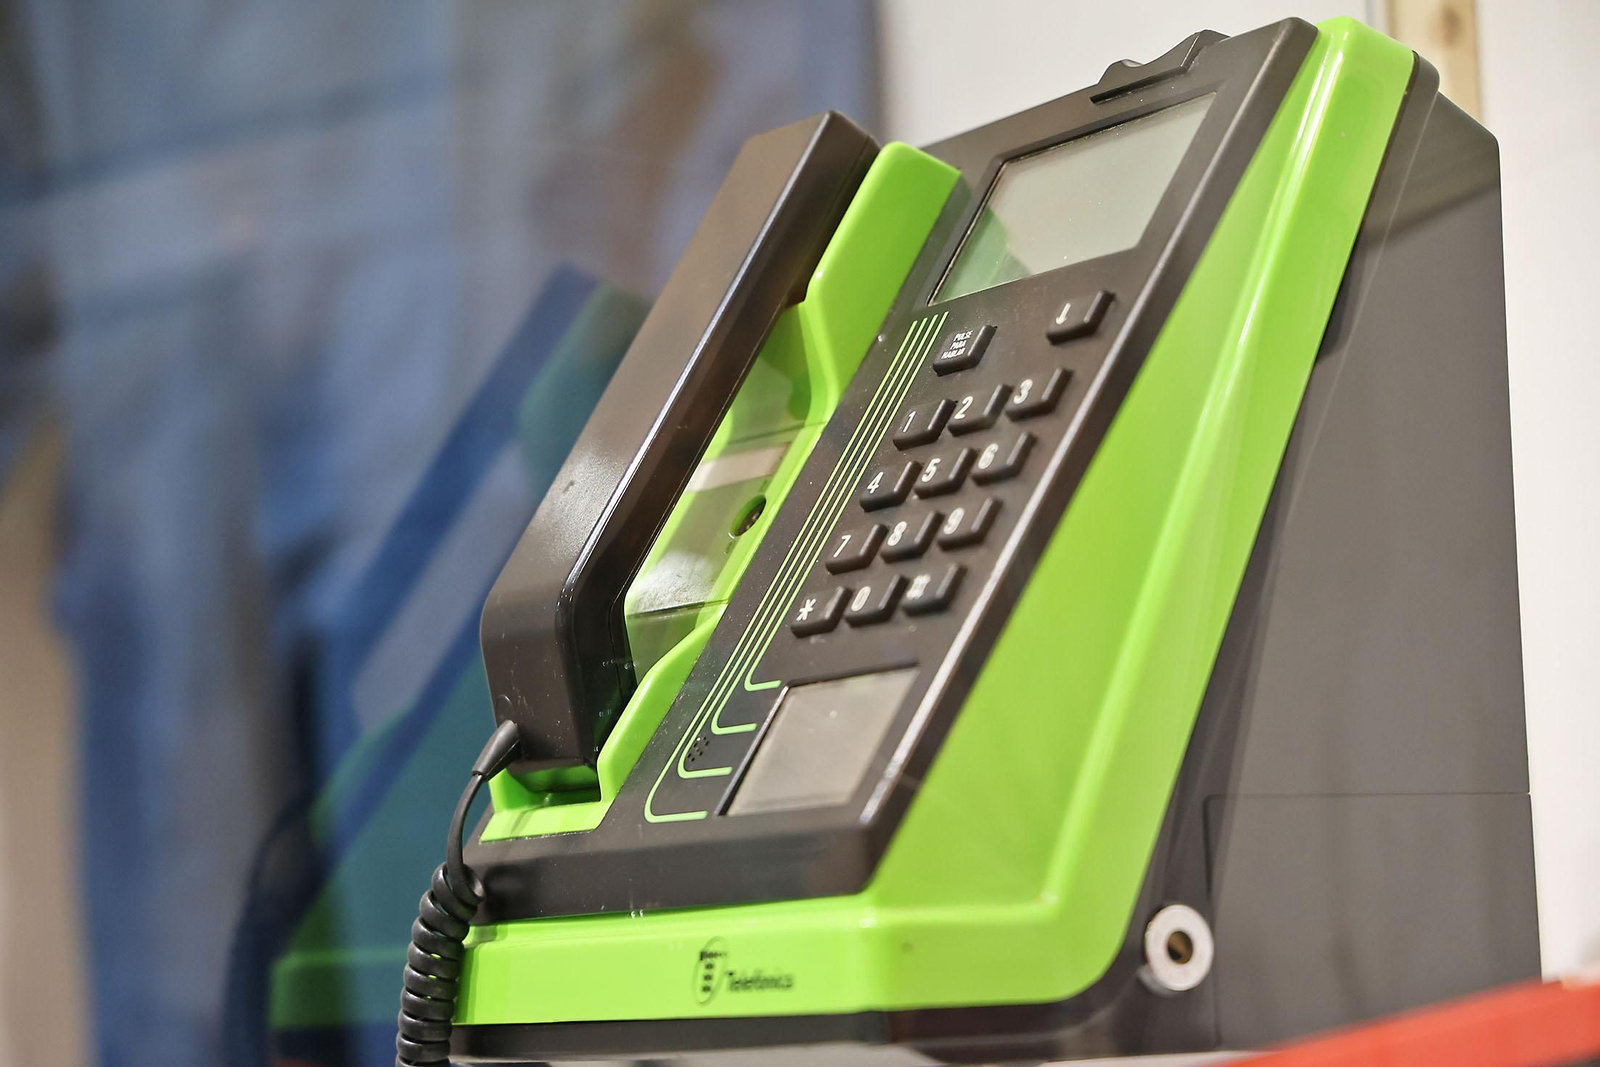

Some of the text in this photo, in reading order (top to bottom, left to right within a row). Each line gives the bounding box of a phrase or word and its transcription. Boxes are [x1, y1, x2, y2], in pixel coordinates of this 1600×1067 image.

[902, 378, 1033, 433] 1 2 3
[866, 442, 999, 494] 4 5 6
[833, 507, 965, 558] 7 8 9
[851, 585, 871, 612] 0
